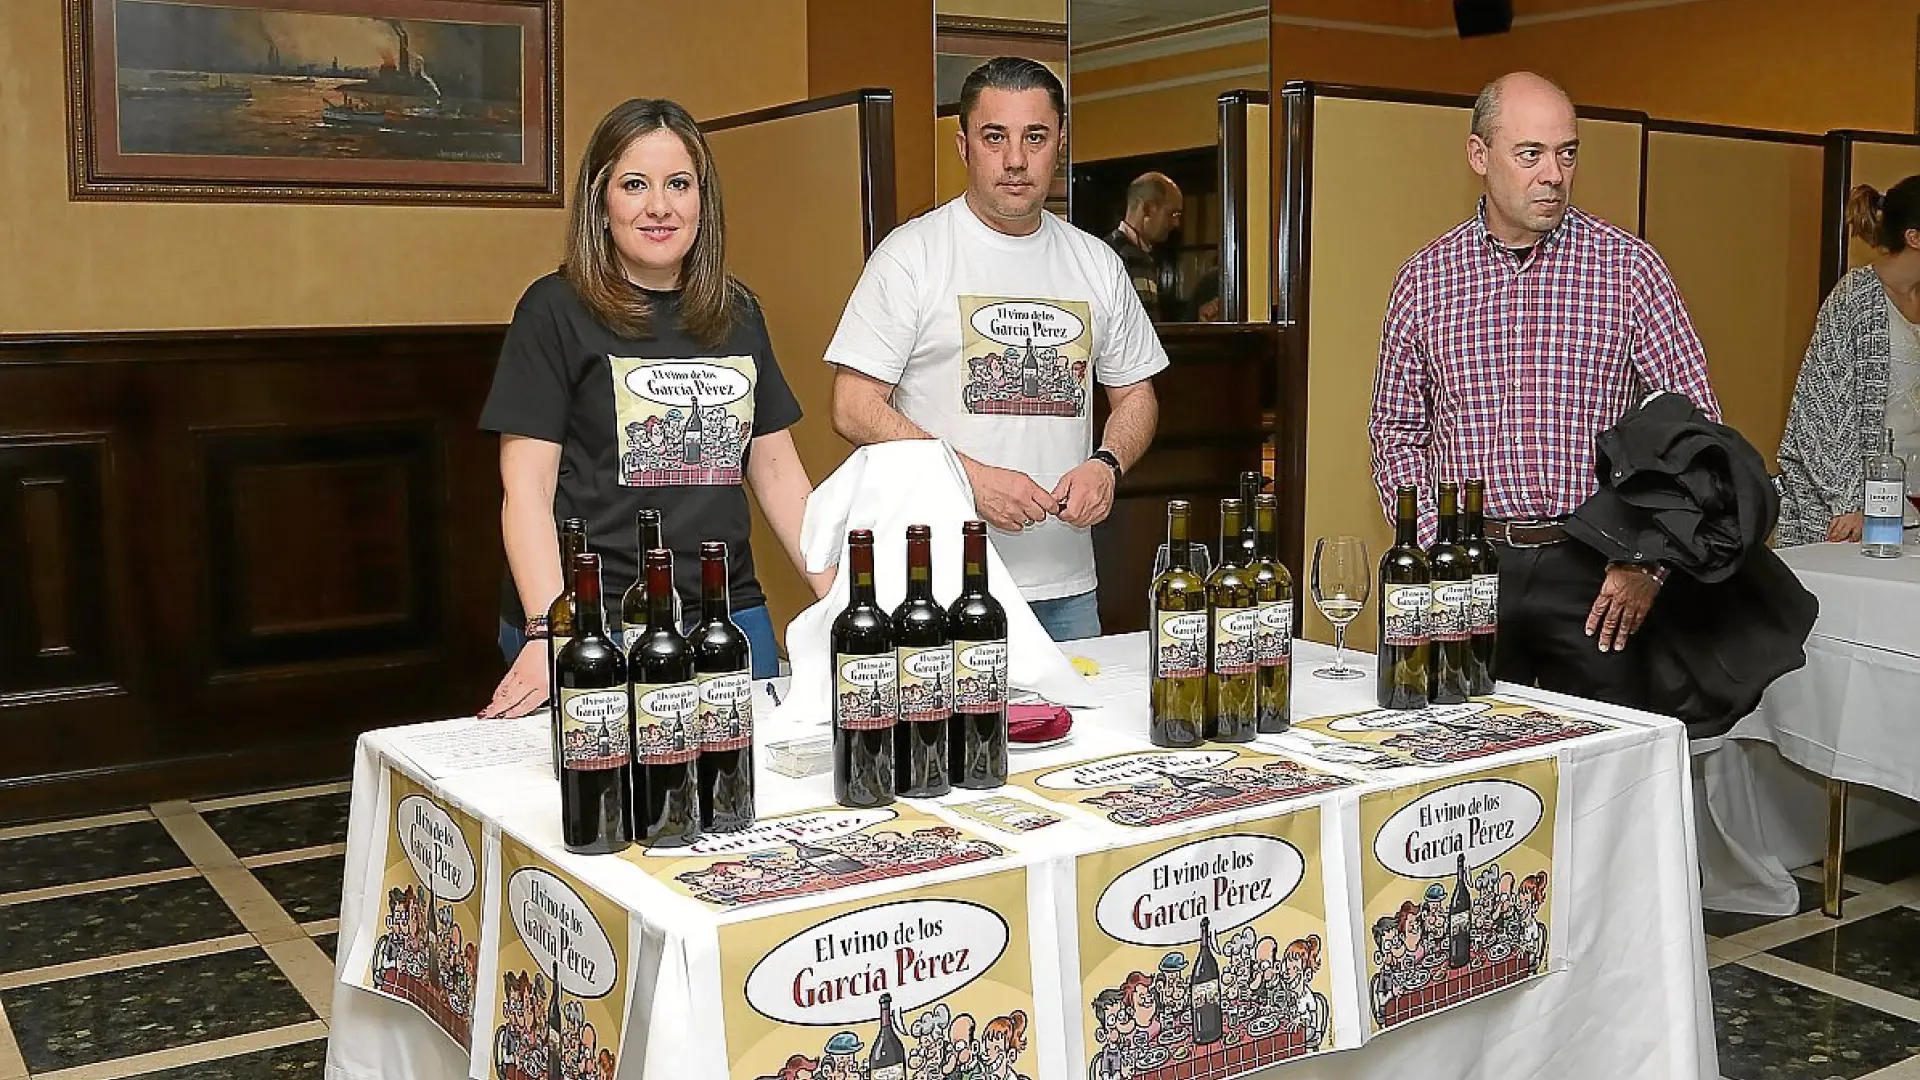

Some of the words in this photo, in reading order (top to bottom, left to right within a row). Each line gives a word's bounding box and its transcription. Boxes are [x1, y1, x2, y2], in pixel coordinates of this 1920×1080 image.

[990, 318, 1029, 336] García
[1032, 321, 1068, 338] Pérez
[997, 307, 1007, 319] El
[1008, 309, 1029, 320] vino
[647, 379, 694, 395] García
[694, 379, 735, 395] Pérez
[665, 370, 688, 380] vino
[1419, 806, 1432, 828] El
[1435, 801, 1465, 823] vino
[1468, 796, 1482, 816] de
[1483, 794, 1500, 811] los
[1405, 826, 1463, 864] García
[1468, 816, 1515, 849] Pérez
[433, 842, 462, 889] Pérez
[1153, 864, 1169, 891] El
[1173, 857, 1209, 885] vino
[1212, 853, 1229, 876] de
[1232, 850, 1254, 871] los
[531, 879, 539, 905] El
[539, 889, 558, 919] vino
[560, 903, 570, 927] de
[570, 908, 583, 937] los
[1132, 889, 1207, 931] García
[1213, 875, 1273, 912] Pérez
[523, 900, 557, 958] García
[560, 926, 596, 985] Pérez
[815, 934, 834, 963] El
[838, 929, 888, 957] vino
[893, 922, 915, 947] de
[918, 916, 943, 940] los
[792, 961, 888, 1009] García
[894, 946, 970, 988] Pérez
